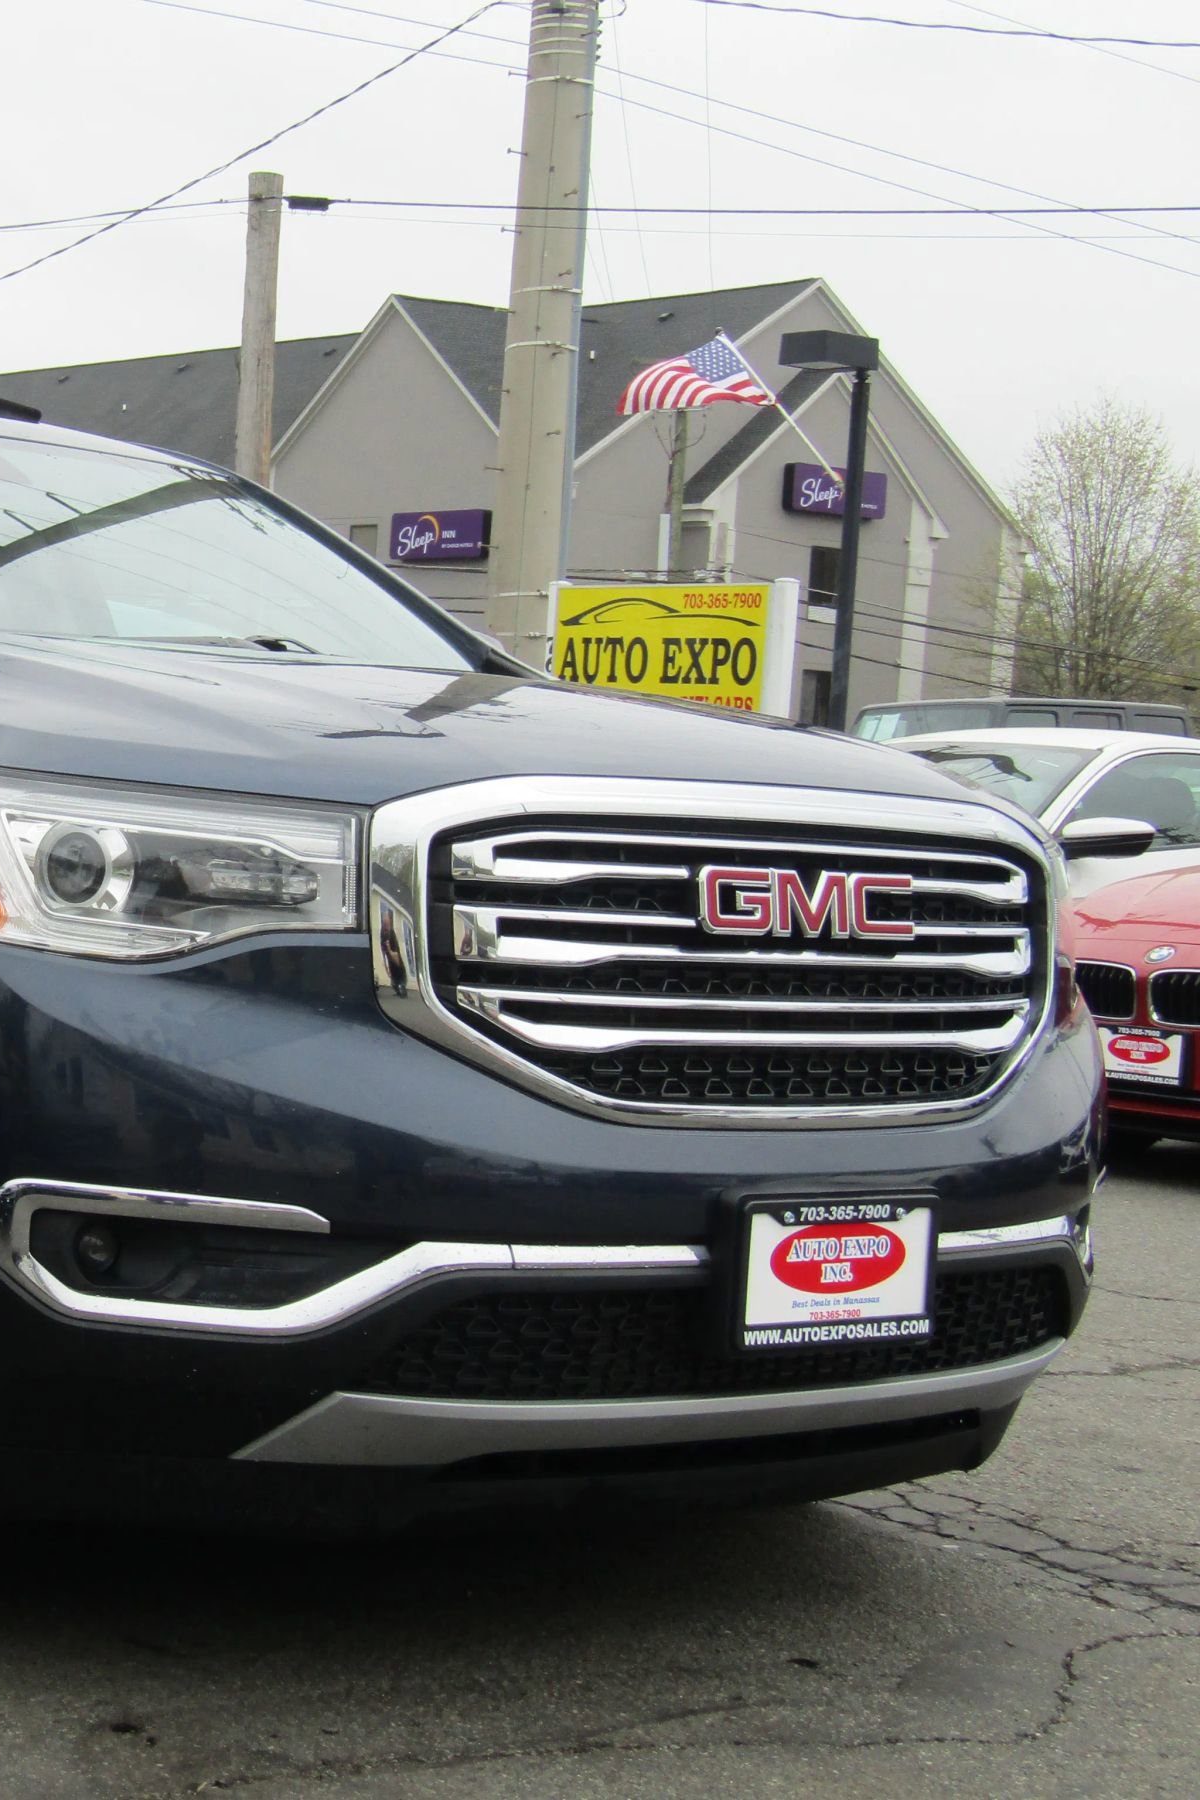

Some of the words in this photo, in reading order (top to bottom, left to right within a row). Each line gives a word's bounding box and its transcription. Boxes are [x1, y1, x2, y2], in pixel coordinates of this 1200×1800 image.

[800, 478, 840, 509] Sleep
[397, 525, 435, 556] Sleep
[442, 530, 456, 539] INN
[683, 593, 762, 609] 703-365-7900
[559, 636, 648, 684] AUTO
[659, 636, 757, 686] EXPO
[699, 865, 915, 941] GMC
[799, 1204, 890, 1221] 703-365-7900
[787, 1238, 839, 1262] AUTO
[841, 1235, 890, 1258] EXPO
[822, 1263, 852, 1282] INC.
[791, 1300, 808, 1309] Best
[810, 1298, 831, 1307] Deals
[809, 1309, 861, 1320] 703-365-7900
[744, 1319, 930, 1346] WWW.AUTOEXPOSALES.COM
